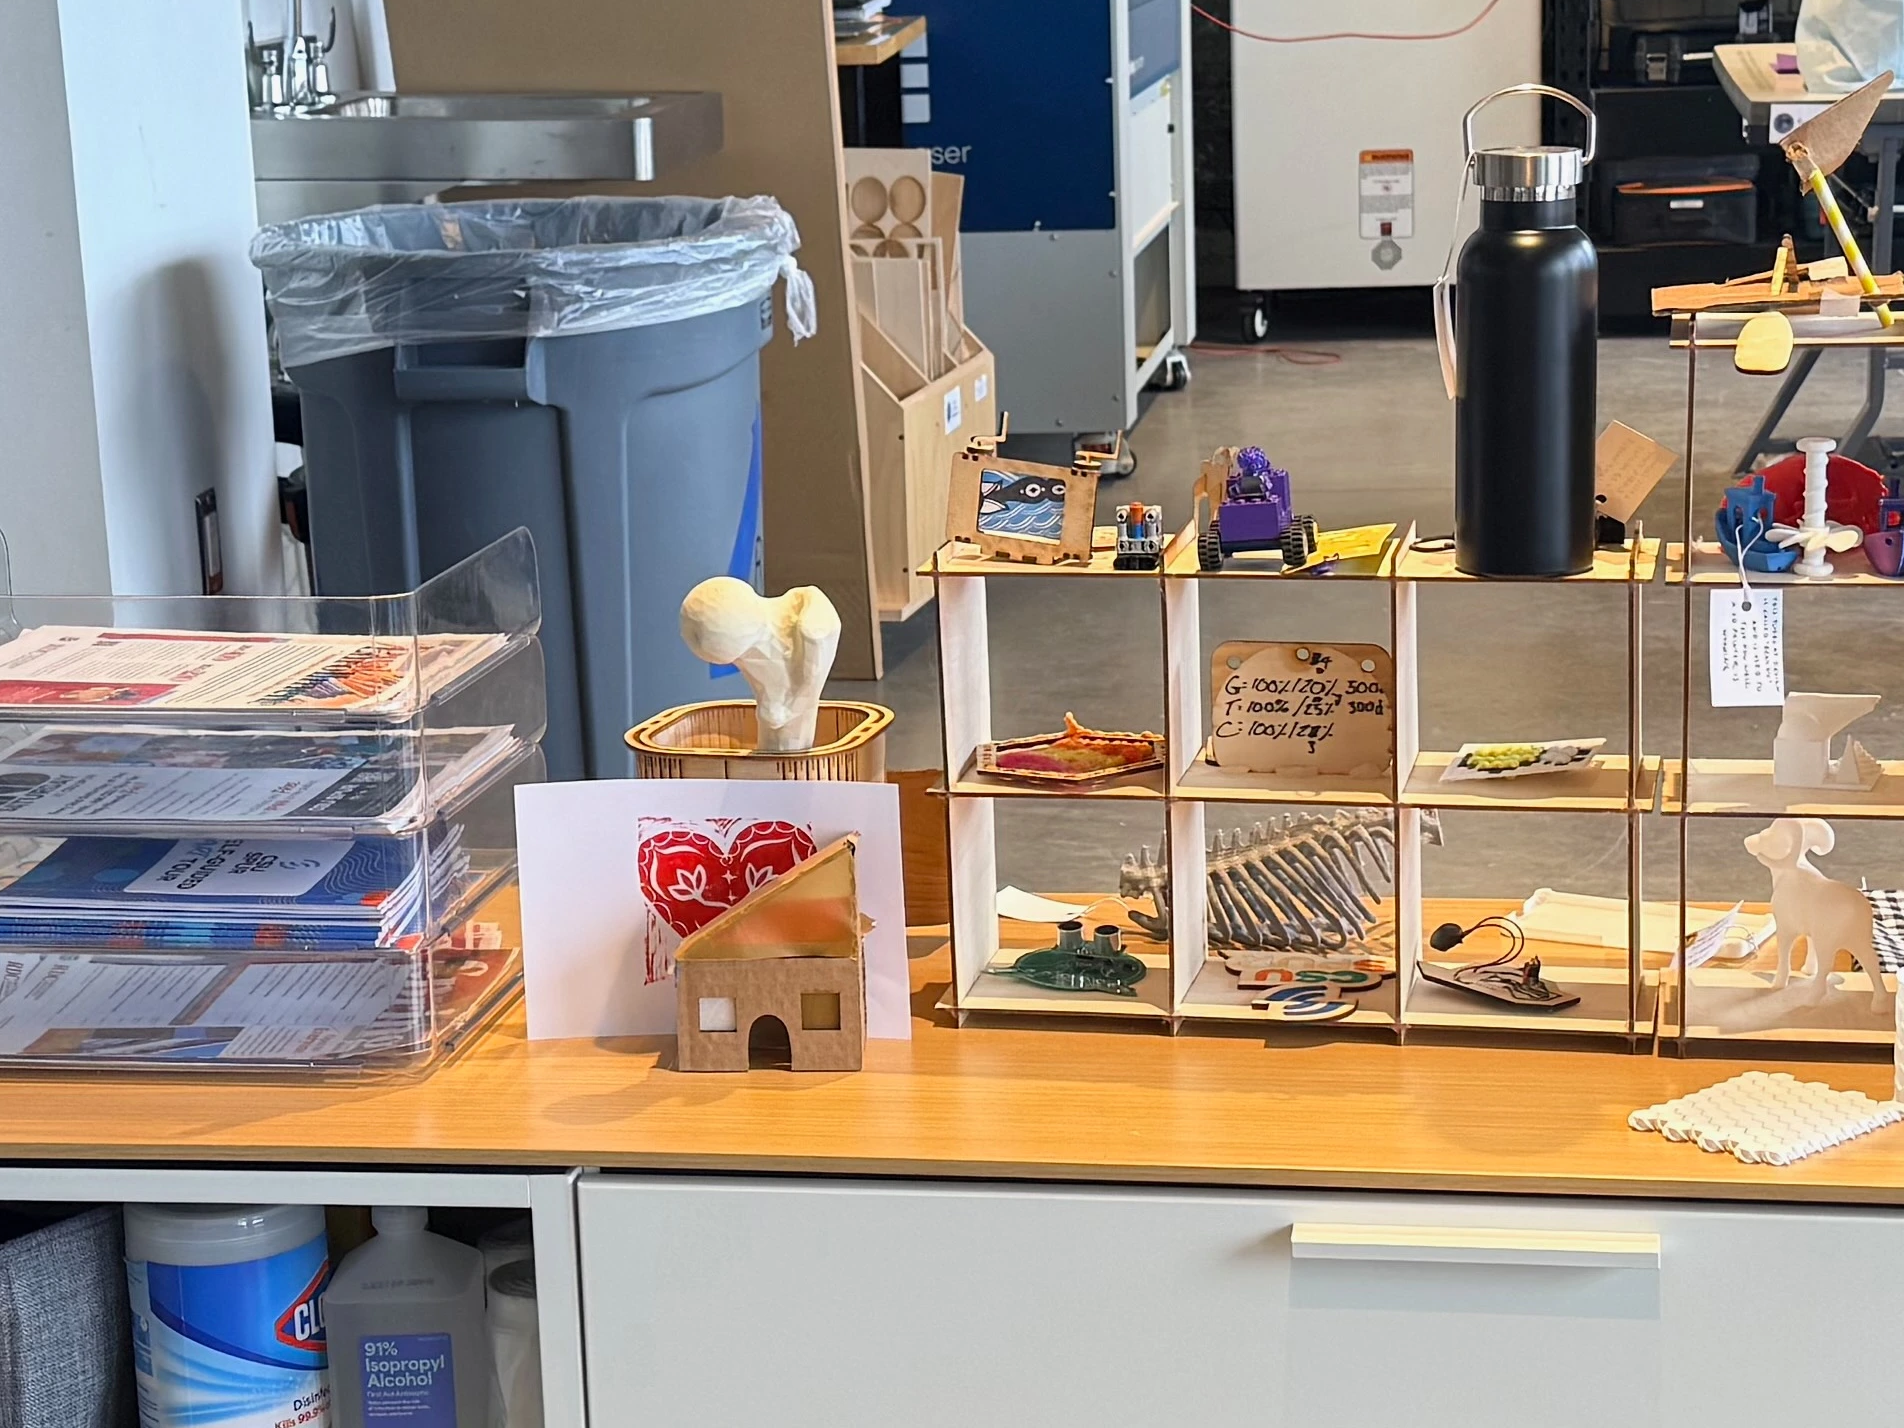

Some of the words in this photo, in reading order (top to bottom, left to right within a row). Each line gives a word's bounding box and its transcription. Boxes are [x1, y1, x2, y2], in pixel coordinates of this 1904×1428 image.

[364, 1341, 398, 1357] 91%
[365, 1354, 445, 1374] Isopropyl
[367, 1371, 432, 1388] Alcohol
